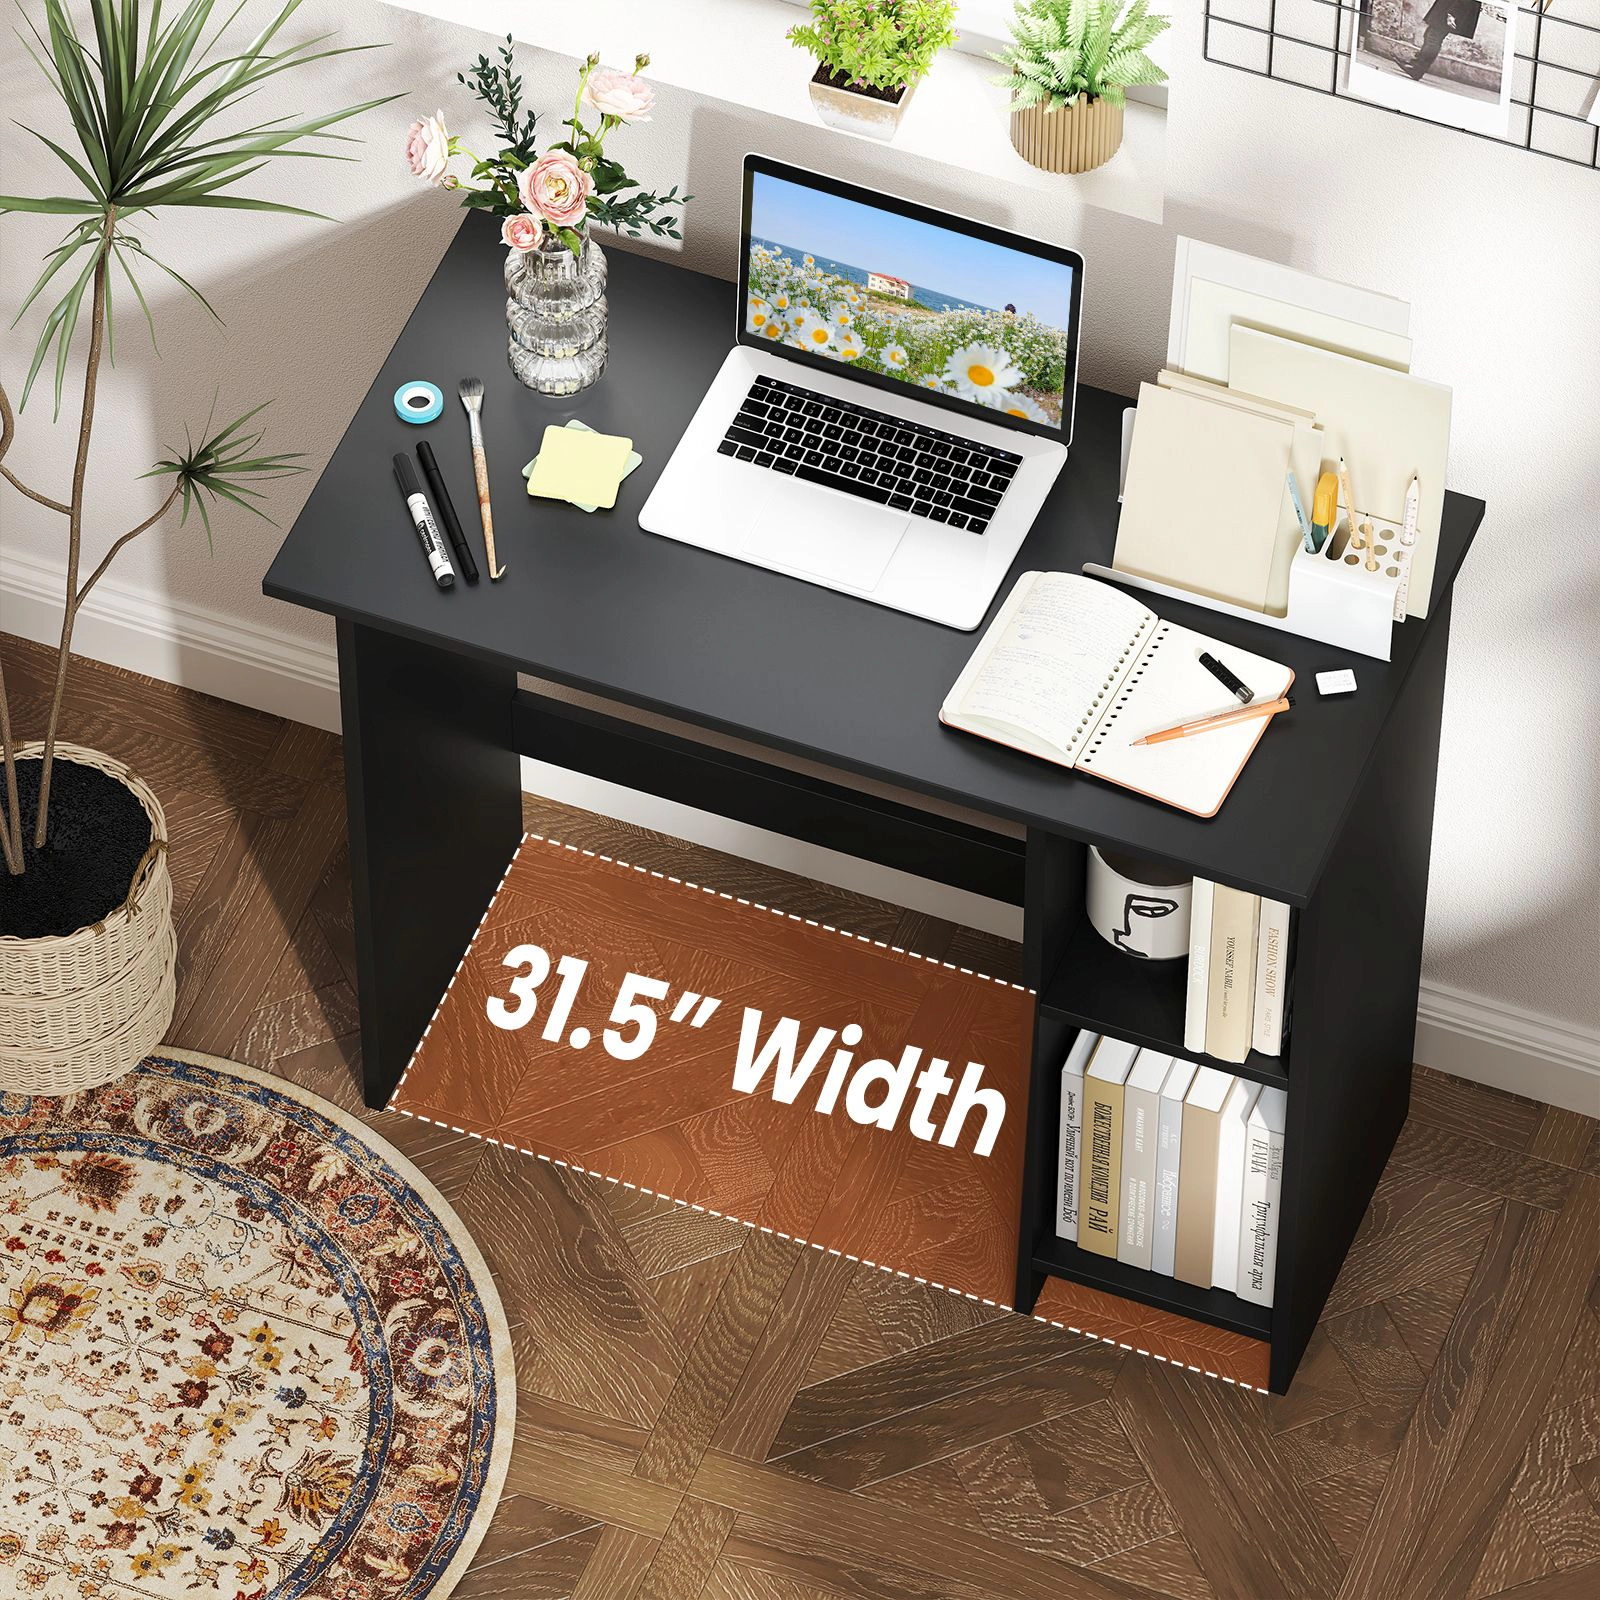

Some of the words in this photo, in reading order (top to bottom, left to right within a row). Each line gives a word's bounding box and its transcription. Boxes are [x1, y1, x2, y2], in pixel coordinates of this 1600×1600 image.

[1225, 936, 1236, 968] YOUSSEF
[1266, 927, 1279, 968] FASHION
[1224, 968, 1234, 990] NABIL
[1265, 968, 1276, 998] SHOW
[1092, 1101, 1112, 1166] БОЖЕСТВЕННАЯ
[1064, 1158, 1074, 1172] кот
[1089, 1164, 1110, 1204] КОМЕДИЯ
[1062, 1206, 1078, 1224] Боб
[1088, 1206, 1114, 1234] РАЙ
[1250, 1200, 1271, 1268] Триумфальная
[1248, 1268, 1264, 1290] арка
